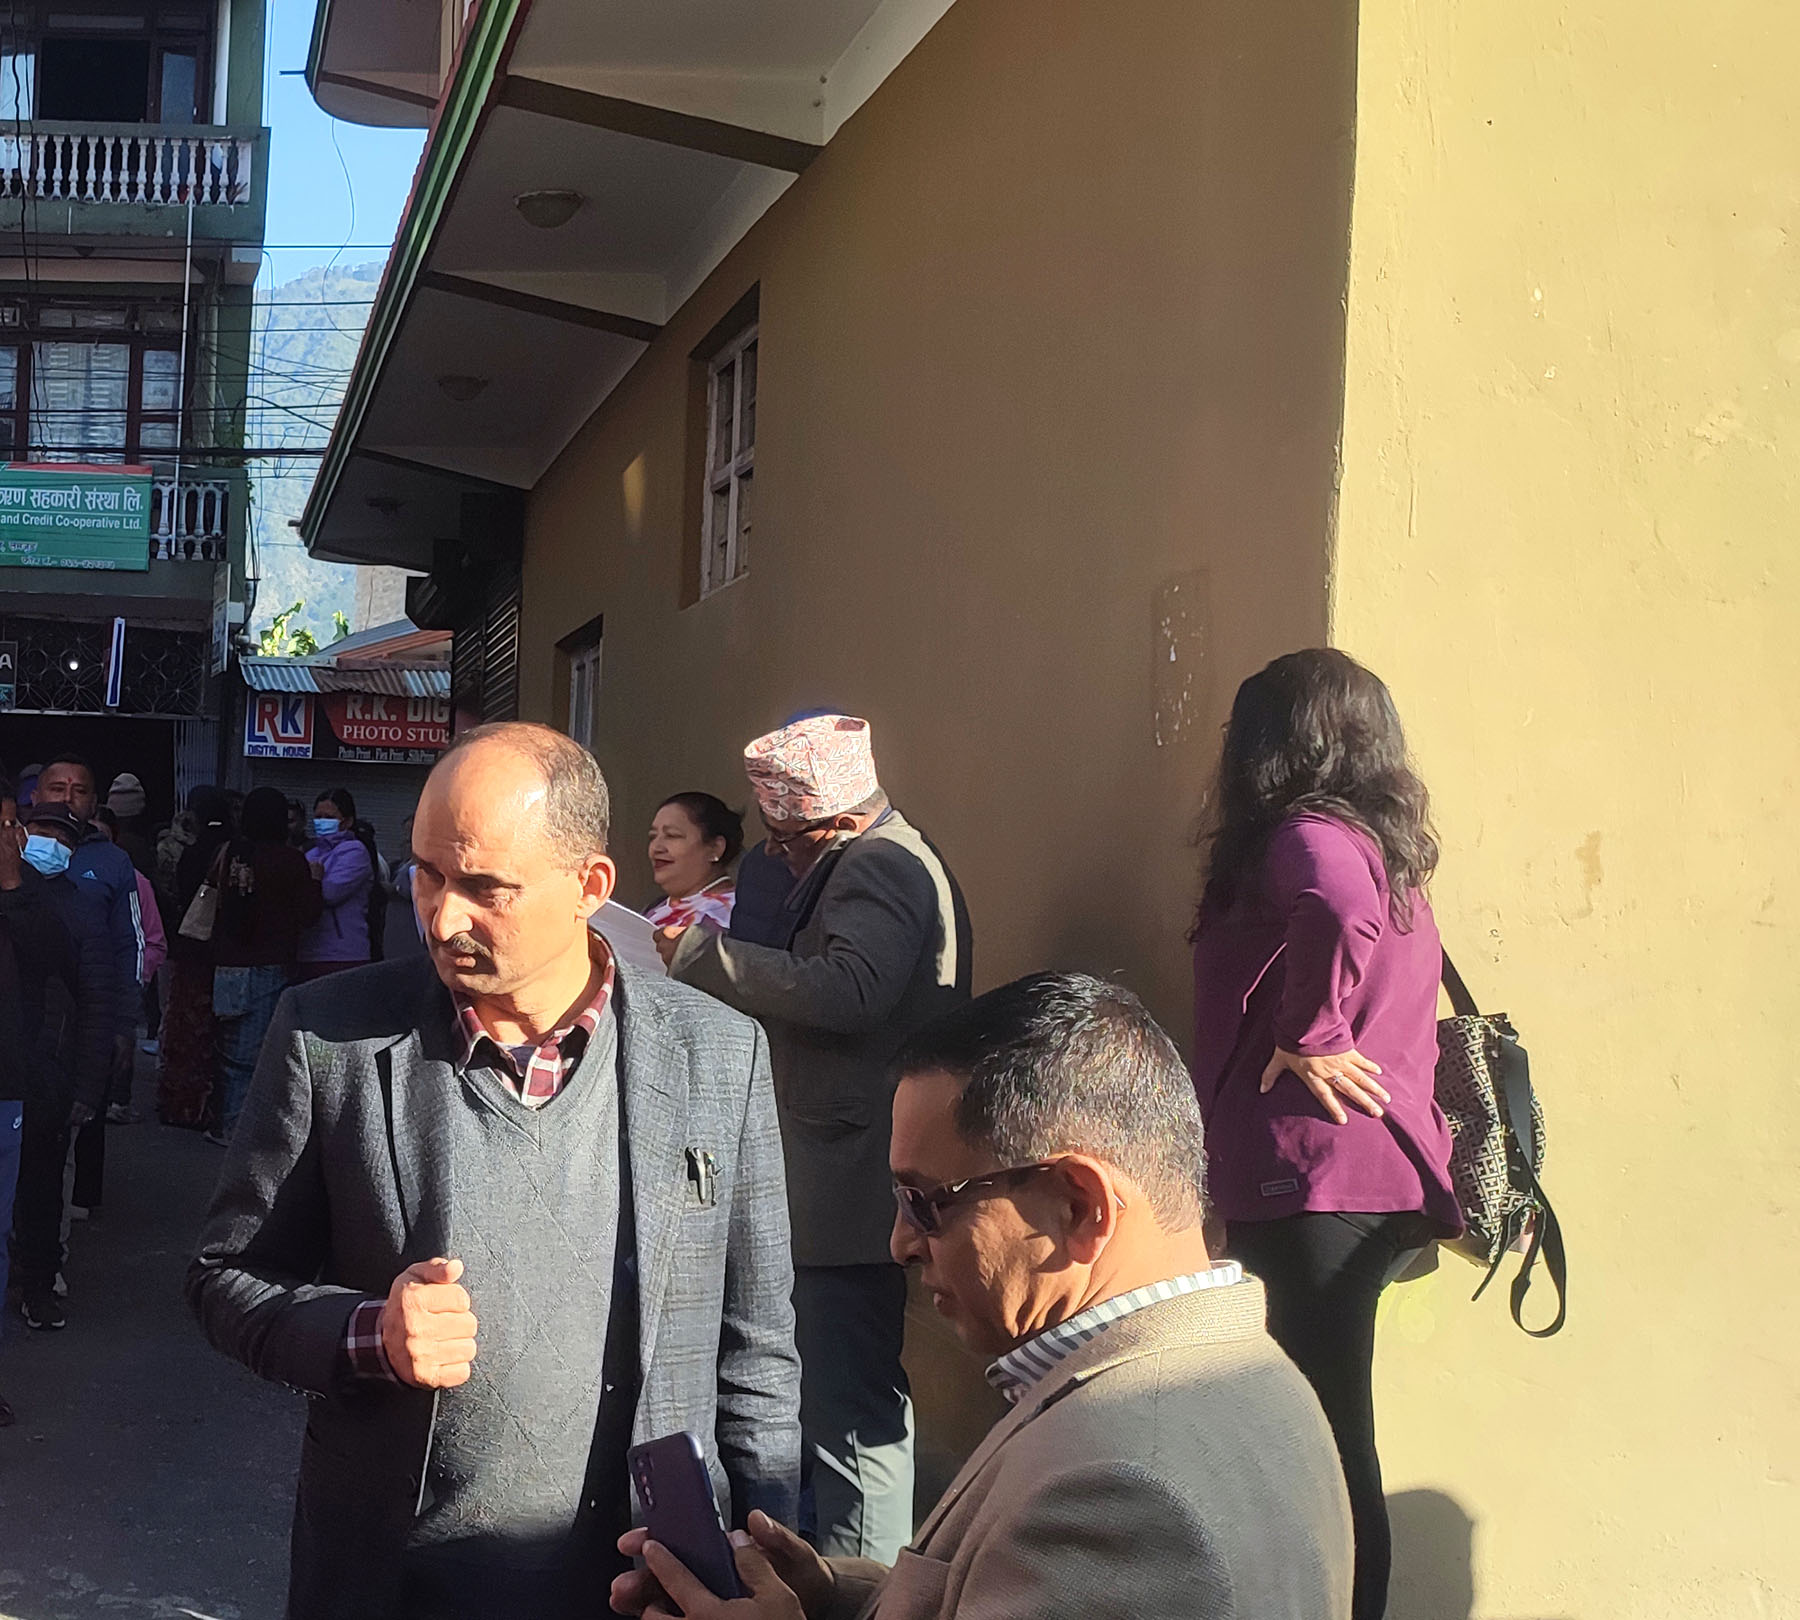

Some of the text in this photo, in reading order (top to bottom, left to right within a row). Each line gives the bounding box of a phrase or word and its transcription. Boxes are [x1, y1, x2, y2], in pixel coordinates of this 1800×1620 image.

[30, 484, 82, 510] सहकारी
[84, 486, 121, 511] संस्था
[123, 487, 144, 512] लि.
[0, 512, 20, 525] and
[22, 513, 53, 526] Credit
[55, 515, 121, 530] Co-operative
[123, 517, 143, 530] Ltd.
[254, 696, 307, 740] RK
[346, 695, 398, 721] R.K.
[342, 724, 402, 741] PHOTO
[247, 744, 311, 757] DIGITAL HOUSE
